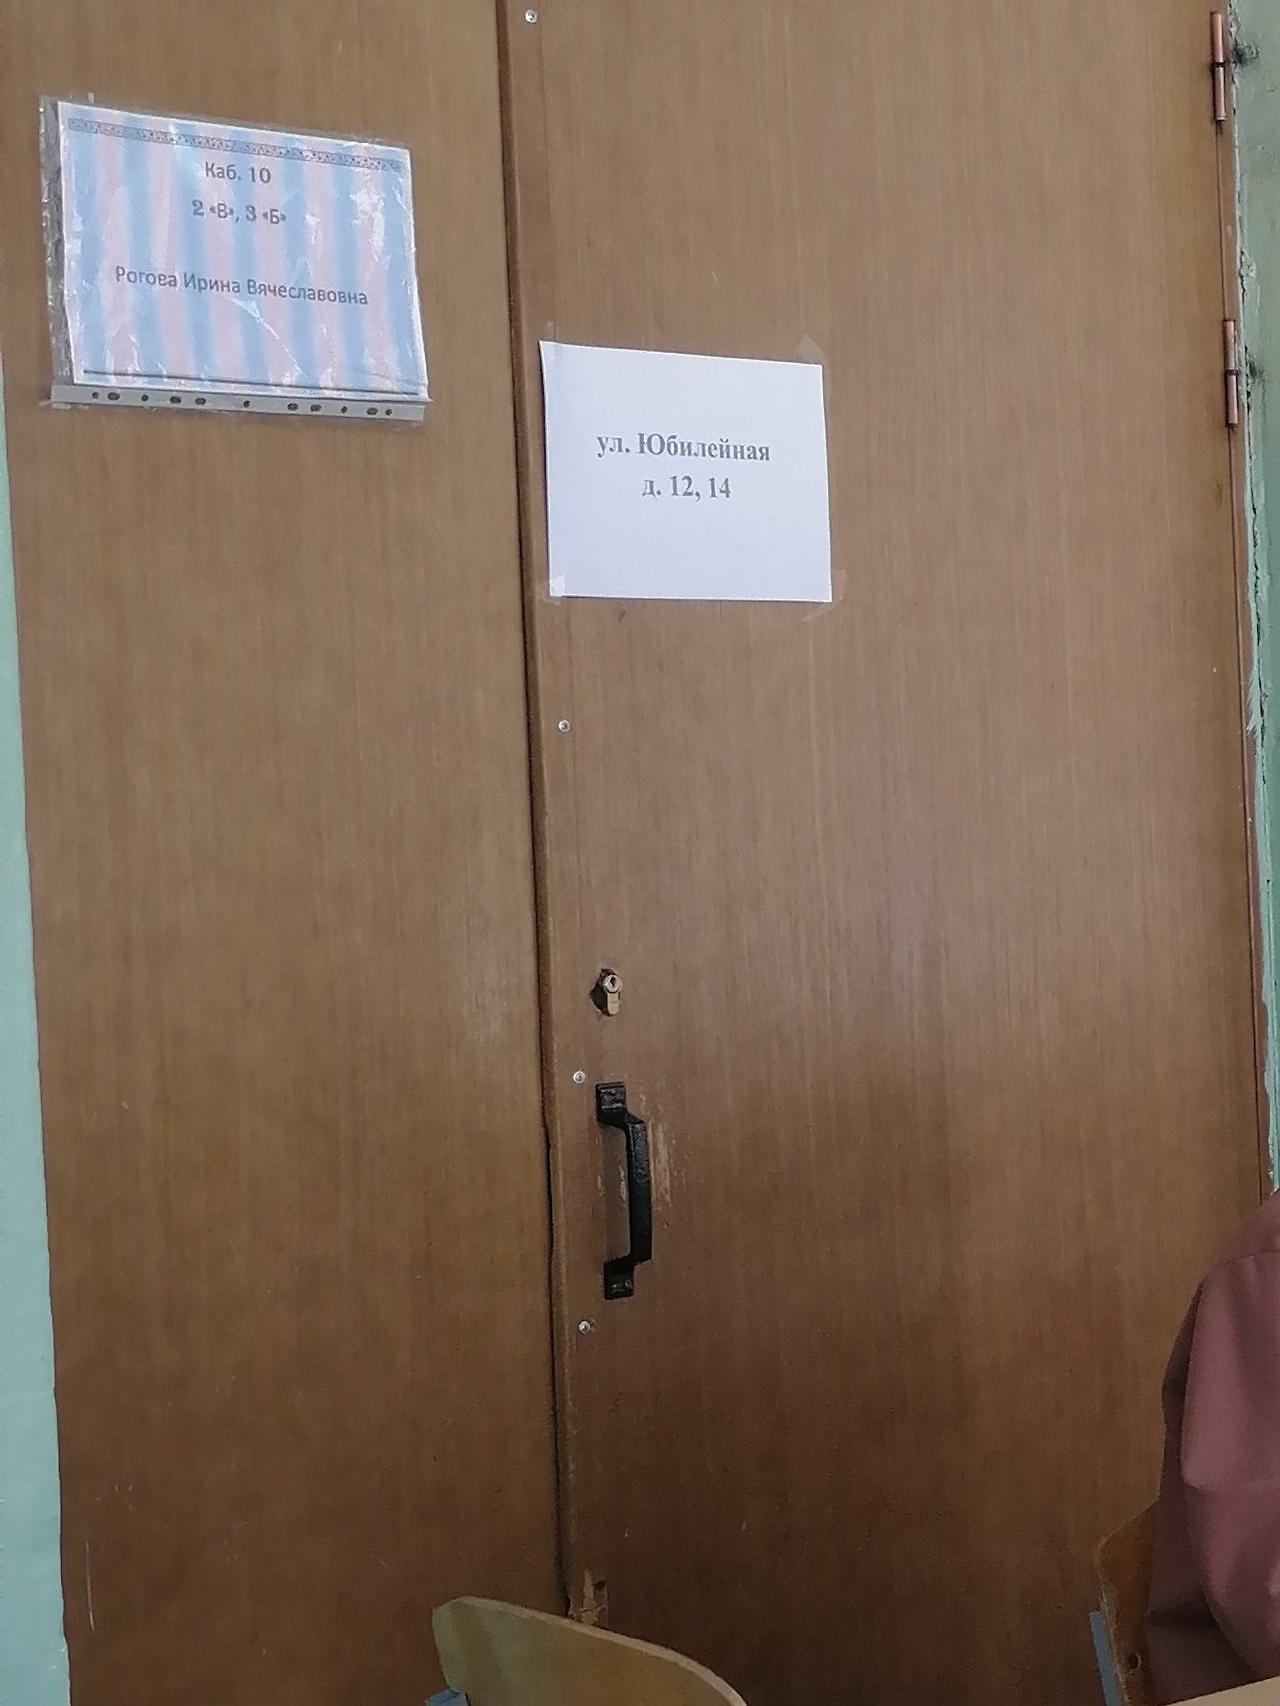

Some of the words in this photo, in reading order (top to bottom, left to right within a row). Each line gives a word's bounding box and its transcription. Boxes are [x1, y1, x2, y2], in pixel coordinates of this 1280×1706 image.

[205, 161, 242, 181] Каб.
[249, 166, 271, 184] 10
[191, 199, 204, 217] 2
[115, 265, 177, 288] Рогова
[183, 272, 241, 294] Ирина
[247, 278, 369, 306] Вячеславовна
[596, 434, 631, 458] ул.
[637, 432, 771, 462] Юбилейная
[641, 478, 662, 499] д.
[669, 475, 701, 501] 12,
[708, 477, 732, 499] 14
